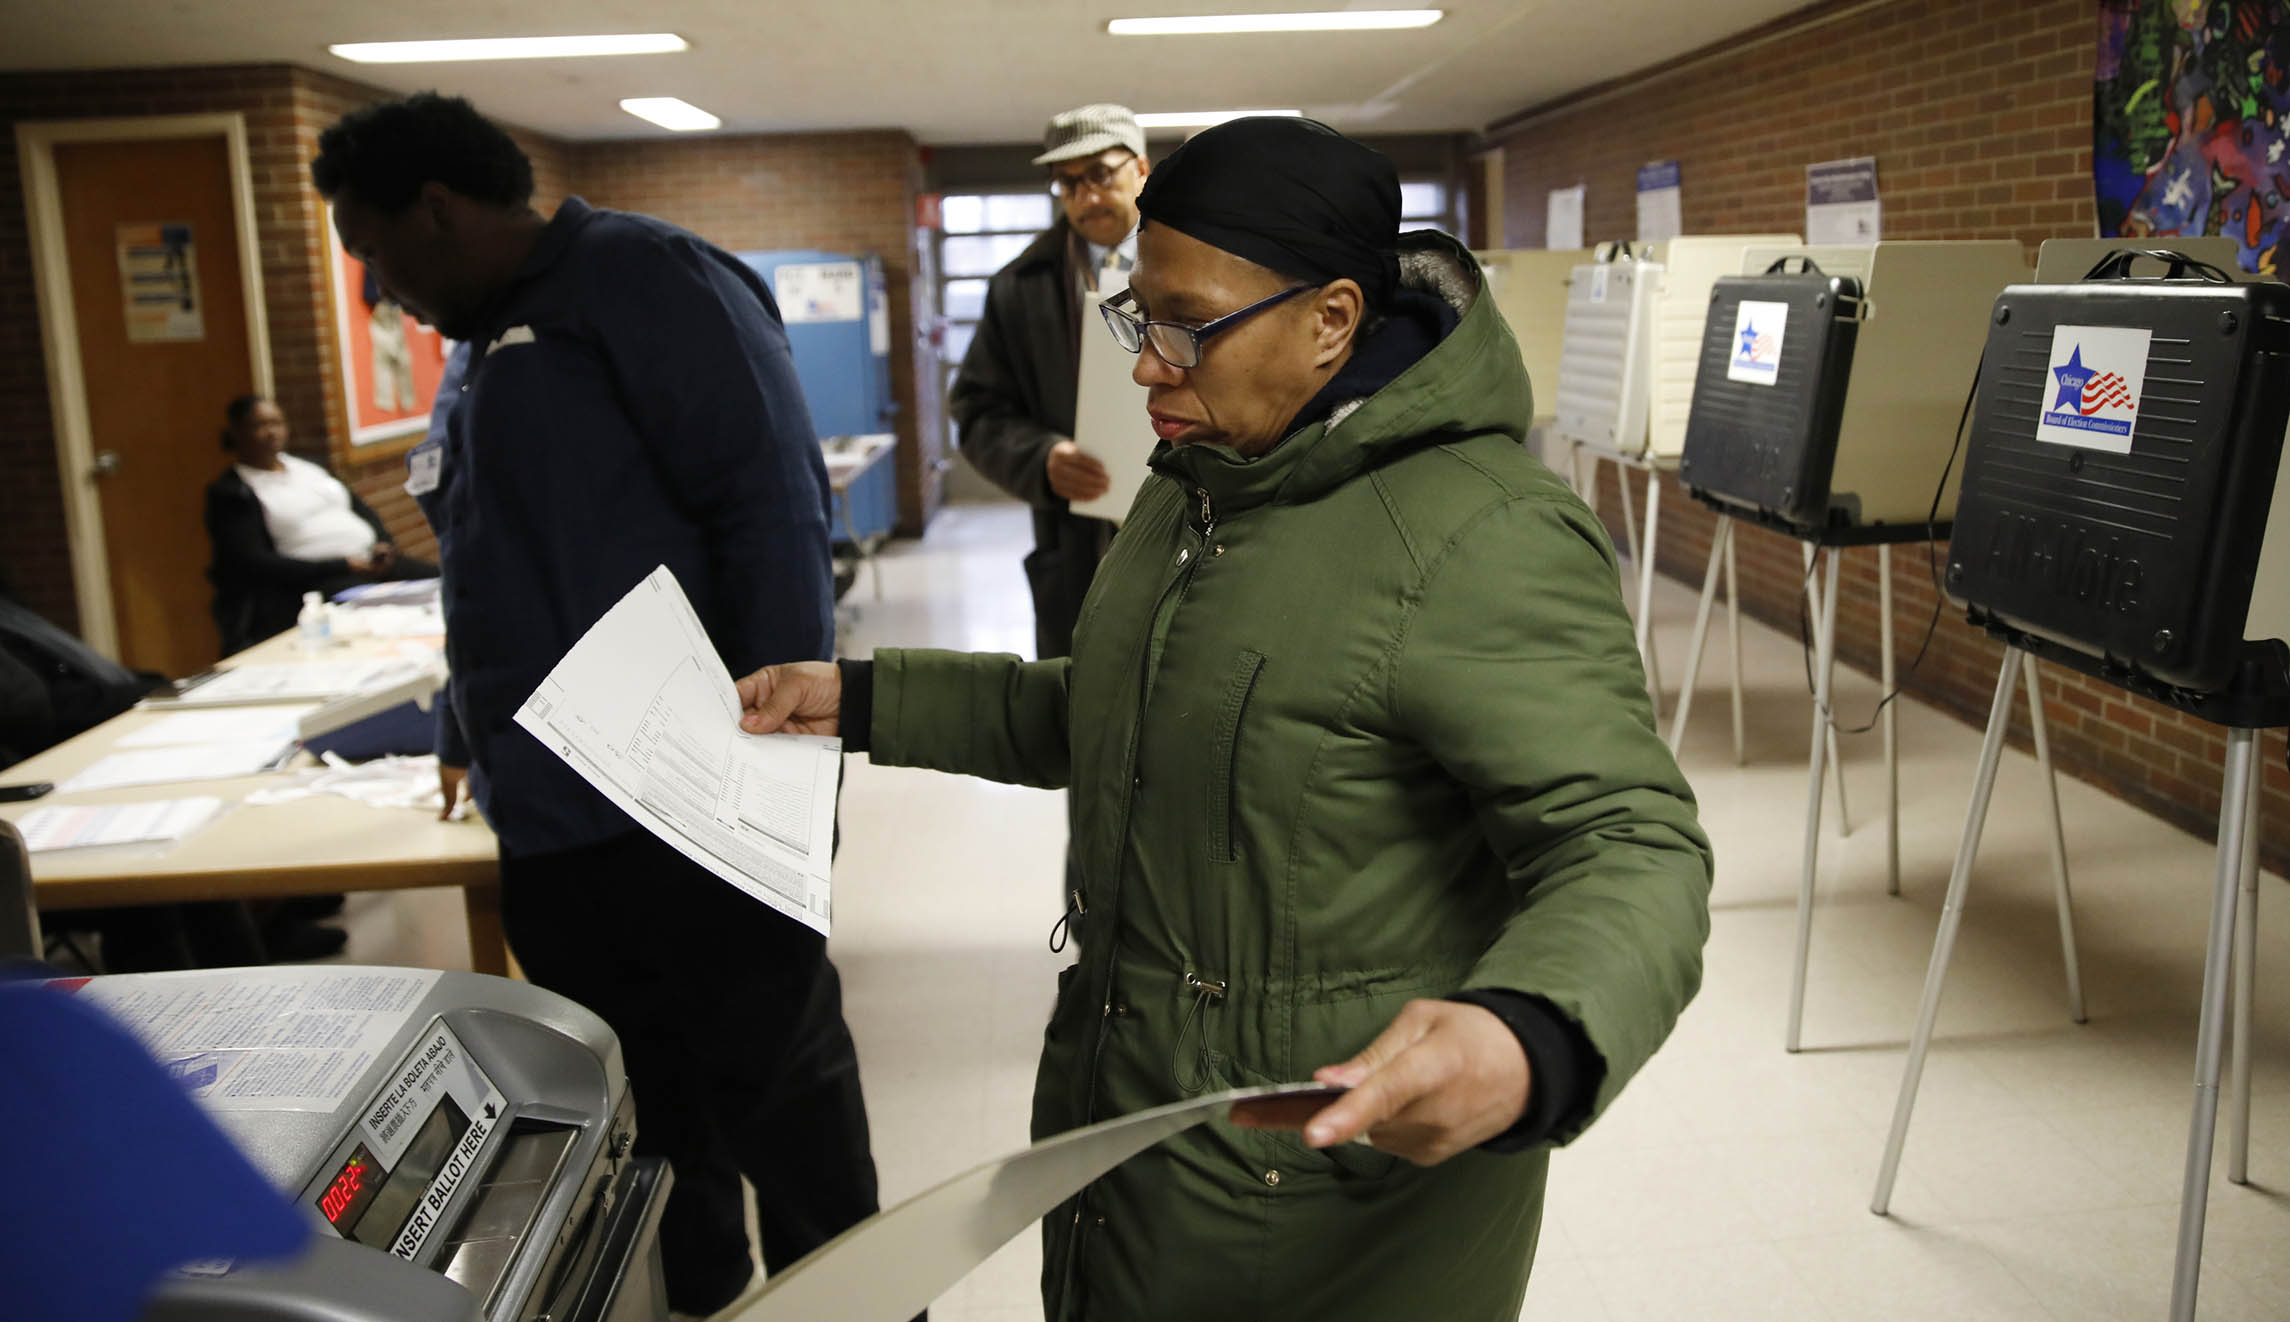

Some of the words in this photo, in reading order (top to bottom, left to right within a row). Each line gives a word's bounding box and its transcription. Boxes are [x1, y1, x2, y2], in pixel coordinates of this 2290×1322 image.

[2061, 373, 2084, 391] Chicago
[2046, 414, 2060, 425] Board
[2068, 416, 2088, 428] Election
[2088, 420, 2127, 433] Commissioners
[368, 1093, 400, 1130] INSERTE
[394, 1084, 408, 1098] LA
[404, 1058, 429, 1088] BOLETA
[425, 1036, 447, 1063] ABAJO
[321, 1165, 360, 1223] 0022
[393, 1206, 433, 1259] NSERT
[428, 1154, 466, 1211] BALLOT
[459, 1120, 488, 1160] HERE
